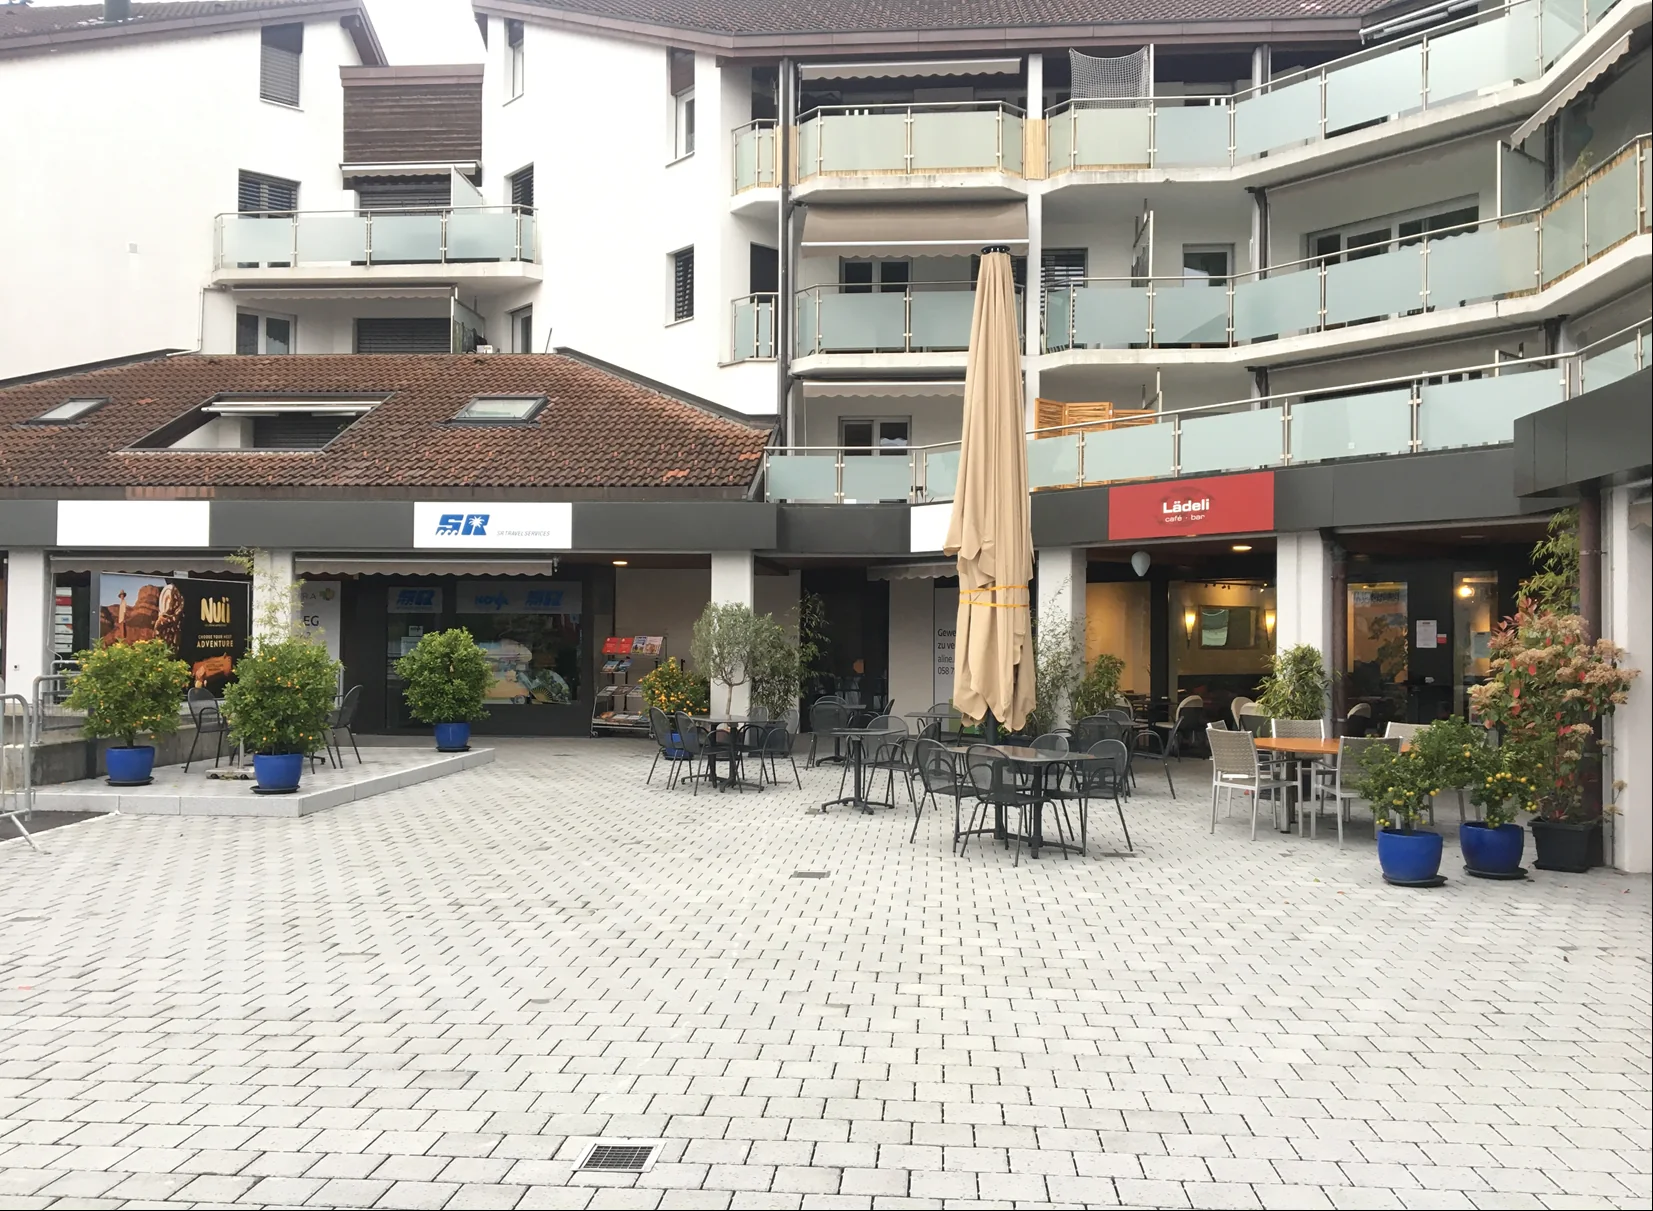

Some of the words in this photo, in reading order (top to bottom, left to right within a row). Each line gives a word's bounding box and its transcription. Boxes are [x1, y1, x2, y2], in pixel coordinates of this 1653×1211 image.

[1162, 498, 1210, 514] Lädeli
[1164, 514, 1183, 523] café
[435, 513, 490, 536] SR
[937, 628, 957, 637] Gewe
[196, 639, 234, 648] ADVENTURE
[937, 642, 946, 650] zu
[946, 642, 956, 650] ve
[937, 654, 955, 663] aline.
[937, 666, 950, 675] 058
